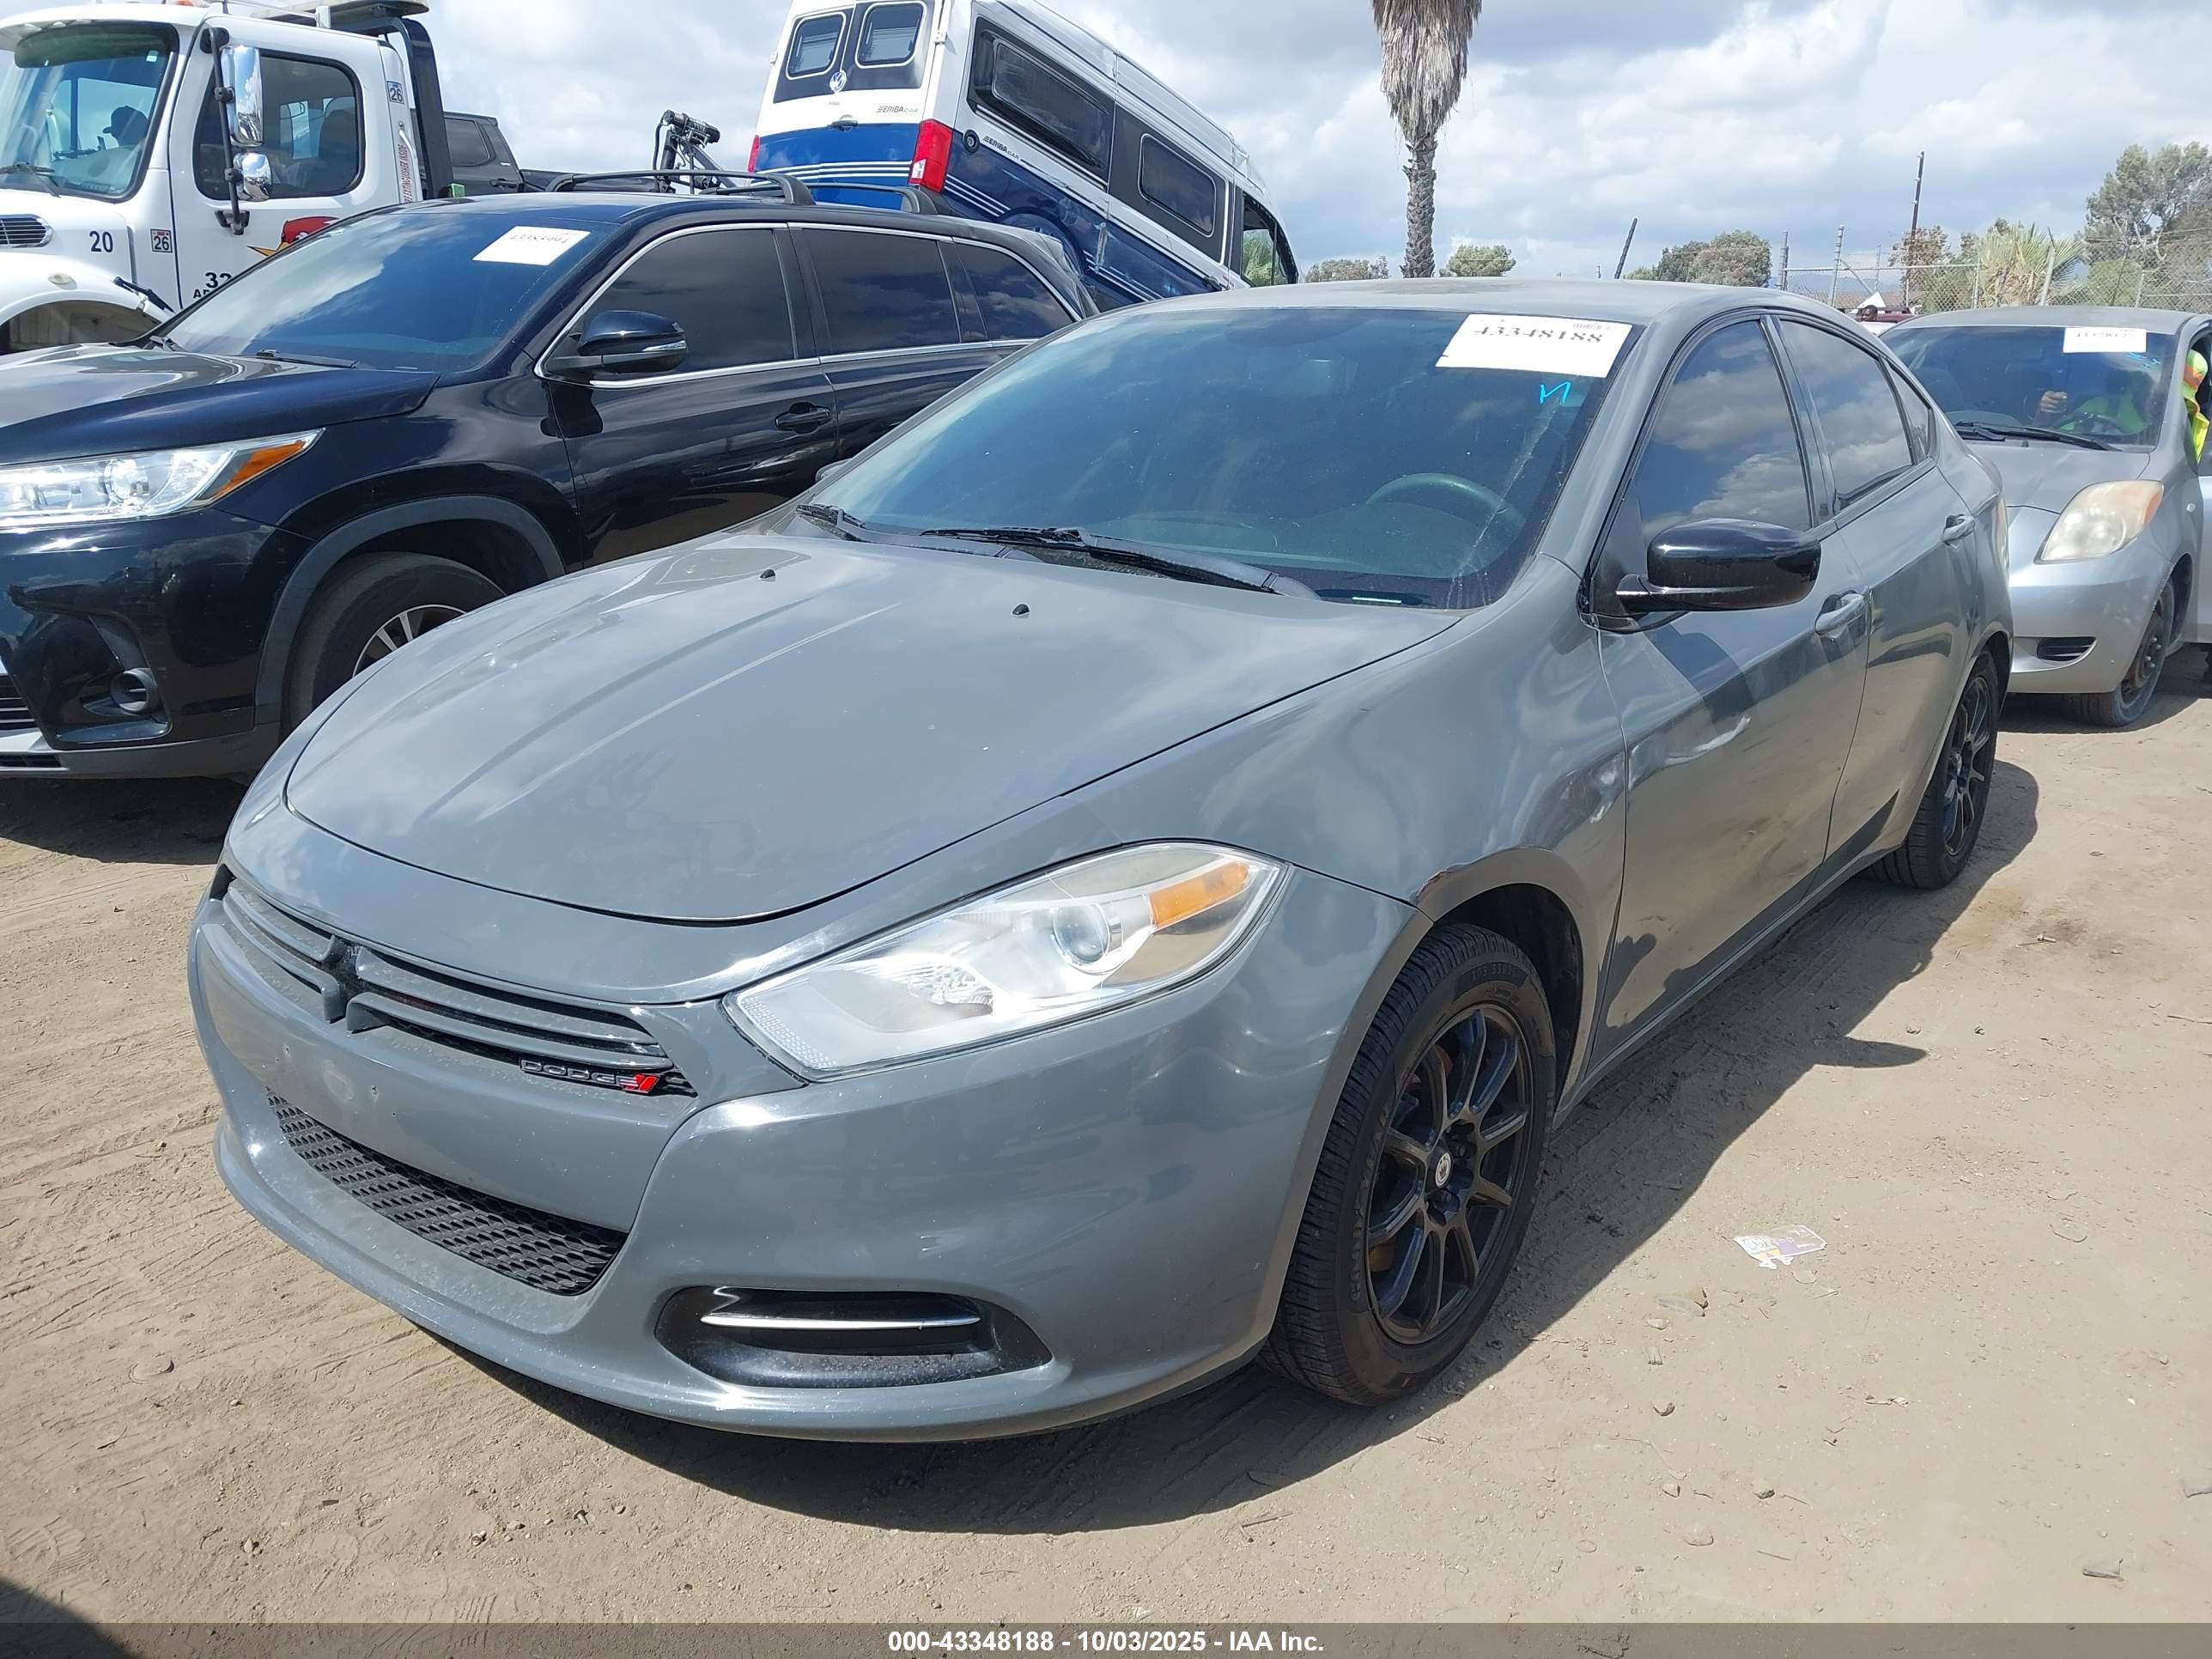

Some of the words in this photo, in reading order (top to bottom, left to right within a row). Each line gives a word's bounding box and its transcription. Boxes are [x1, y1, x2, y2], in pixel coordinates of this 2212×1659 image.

[389, 88, 403, 101] 26
[89, 230, 113, 252] 20
[153, 236, 170, 251] 26
[1474, 325, 1603, 343] 43348188
[520, 1057, 639, 1087] DODGE
